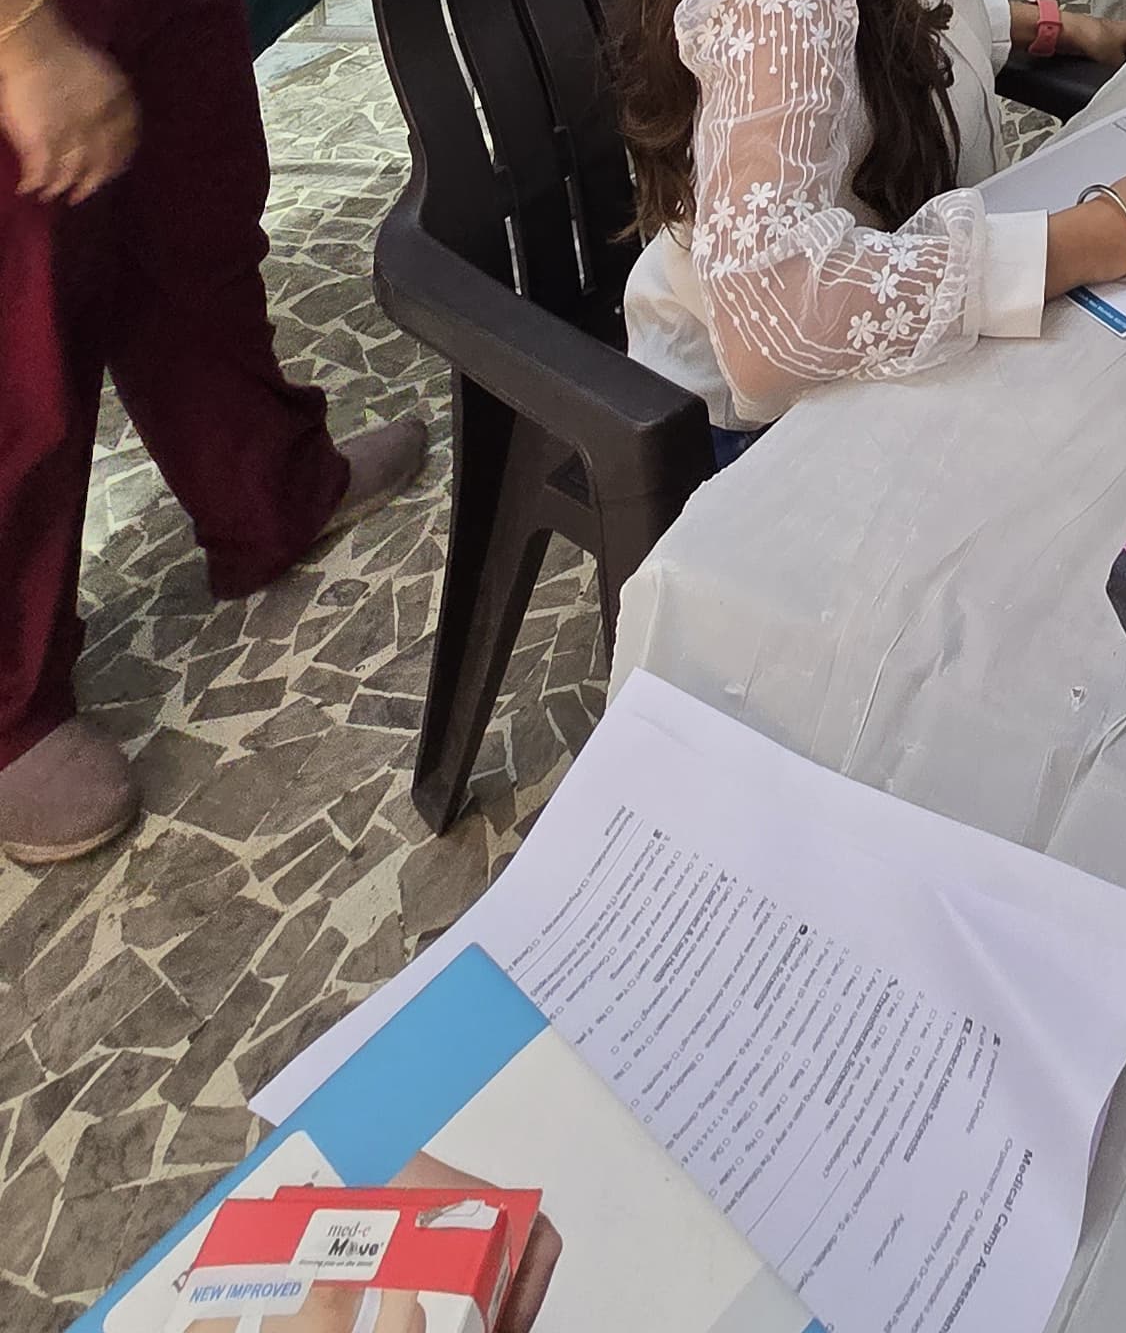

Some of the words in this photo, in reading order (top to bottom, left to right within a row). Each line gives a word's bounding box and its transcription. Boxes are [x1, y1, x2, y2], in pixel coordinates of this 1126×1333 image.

[672, 874, 686, 890] you
[686, 882, 700, 899] you
[725, 908, 739, 925] you
[775, 921, 788, 935] Do
[713, 925, 730, 947] have
[765, 934, 780, 951] you
[779, 936, 801, 965] Dental
[787, 937, 814, 972] Difficulty
[751, 965, 786, 1010] Screening
[854, 992, 868, 1010] you
[907, 1001, 921, 1018] Are
[834, 1010, 859, 1048] currently
[849, 991, 891, 1058] Physiotherapy
[897, 1019, 911, 1037] you
[918, 1021, 932, 1038] Yes
[941, 1021, 953, 1035] Do
[878, 1037, 903, 1077] currently
[932, 1037, 946, 1056] you
[943, 1035, 968, 1077] General
[903, 1056, 916, 1072] No
[921, 1056, 938, 1080] have
[823, 1059, 857, 1105] Screening
[911, 1080, 926, 1099] any
[928, 1078, 950, 1111] Health
[877, 1130, 901, 1166] medical
[901, 1112, 935, 1162] Screening
[986, 1137, 1014, 1191] Organized
[1003, 1148, 1034, 1210] Medical
[948, 1190, 968, 1222] Dental
[981, 1212, 1010, 1255] Camp
[922, 1253, 934, 1266] by
[190, 1286, 225, 1303] NEW
[226, 1282, 303, 1301] IMPROVED
[938, 1255, 988, 1333] Assessmen
